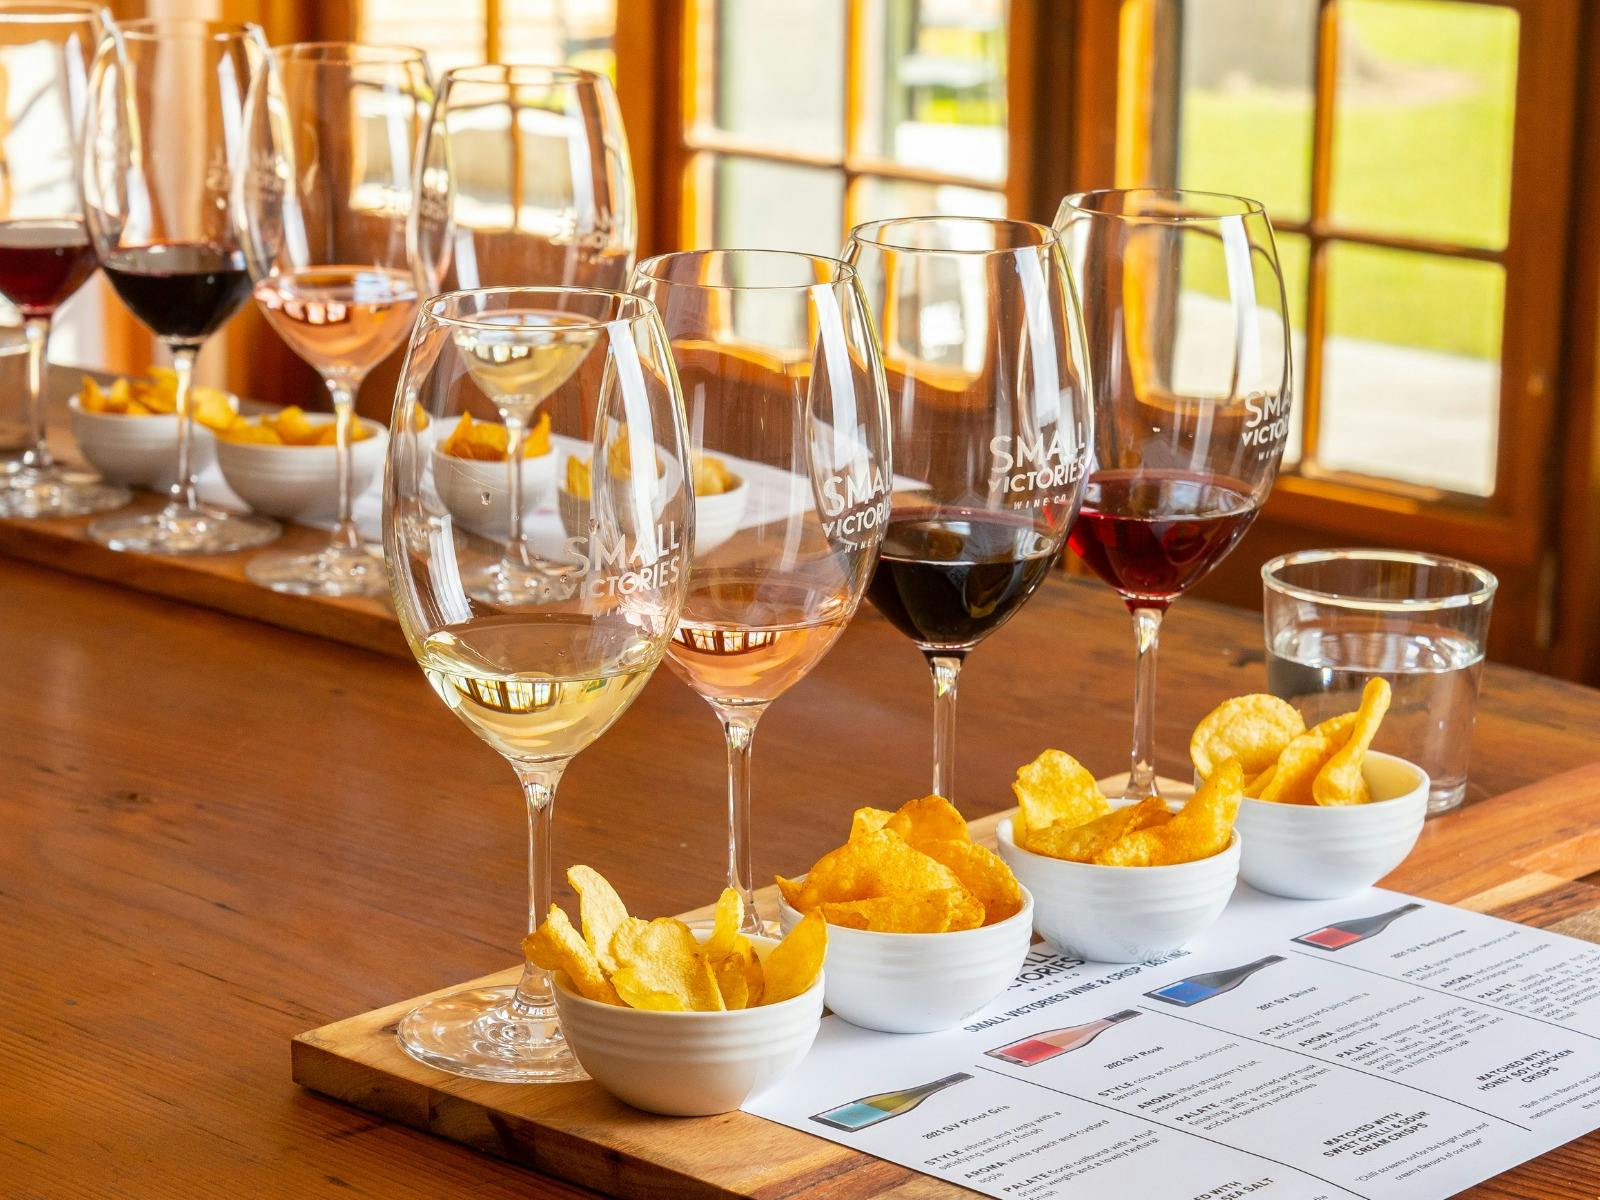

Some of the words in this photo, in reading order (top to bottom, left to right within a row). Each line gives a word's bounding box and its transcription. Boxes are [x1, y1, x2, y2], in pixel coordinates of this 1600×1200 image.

[987, 454, 1086, 493] VICTORIES
[1401, 964, 1434, 977] STYLE
[1440, 974, 1474, 988] AROMA
[962, 1016, 1011, 1032] SMALL
[1003, 993, 1070, 1017] VICTORIES
[1063, 982, 1102, 995] WINE
[1105, 966, 1143, 981] CRISP
[1477, 983, 1516, 998] PALATE
[1258, 1022, 1294, 1036] STYLE
[1297, 1031, 1336, 1047] AROMA
[1122, 1054, 1140, 1062] SV
[1335, 1041, 1378, 1058] PALATE
[1475, 1060, 1525, 1081] MATCHED
[1520, 1049, 1550, 1062] WITH
[1477, 1075, 1513, 1091] HONEY
[1510, 1066, 1534, 1077] SOY
[1530, 1049, 1575, 1068] CHICKEN
[1520, 1066, 1560, 1083] CRISPS
[1097, 1082, 1135, 1096] STYLE
[1136, 1092, 1178, 1109] AROMA
[1174, 1103, 1220, 1121] PALATE
[921, 1129, 945, 1139] 2021
[941, 1123, 961, 1132] SV
[959, 1112, 991, 1125] Pinot
[987, 1105, 1011, 1114] Gris
[1322, 1123, 1376, 1146] MATCHED
[1371, 1112, 1404, 1125] WITH
[1322, 1140, 1360, 1157] SWEET
[1357, 1126, 1394, 1142] CHILLI
[1398, 1111, 1431, 1125] SOUR
[1352, 1138, 1392, 1156] CREAM
[1387, 1122, 1429, 1141] CRISPS
[923, 1149, 964, 1165] STYLE
[963, 1161, 1007, 1179] AROMA
[1002, 1173, 1050, 1192] PALATE
[1208, 1181, 1242, 1195] WITH
[1242, 1177, 1274, 1192] SALT
